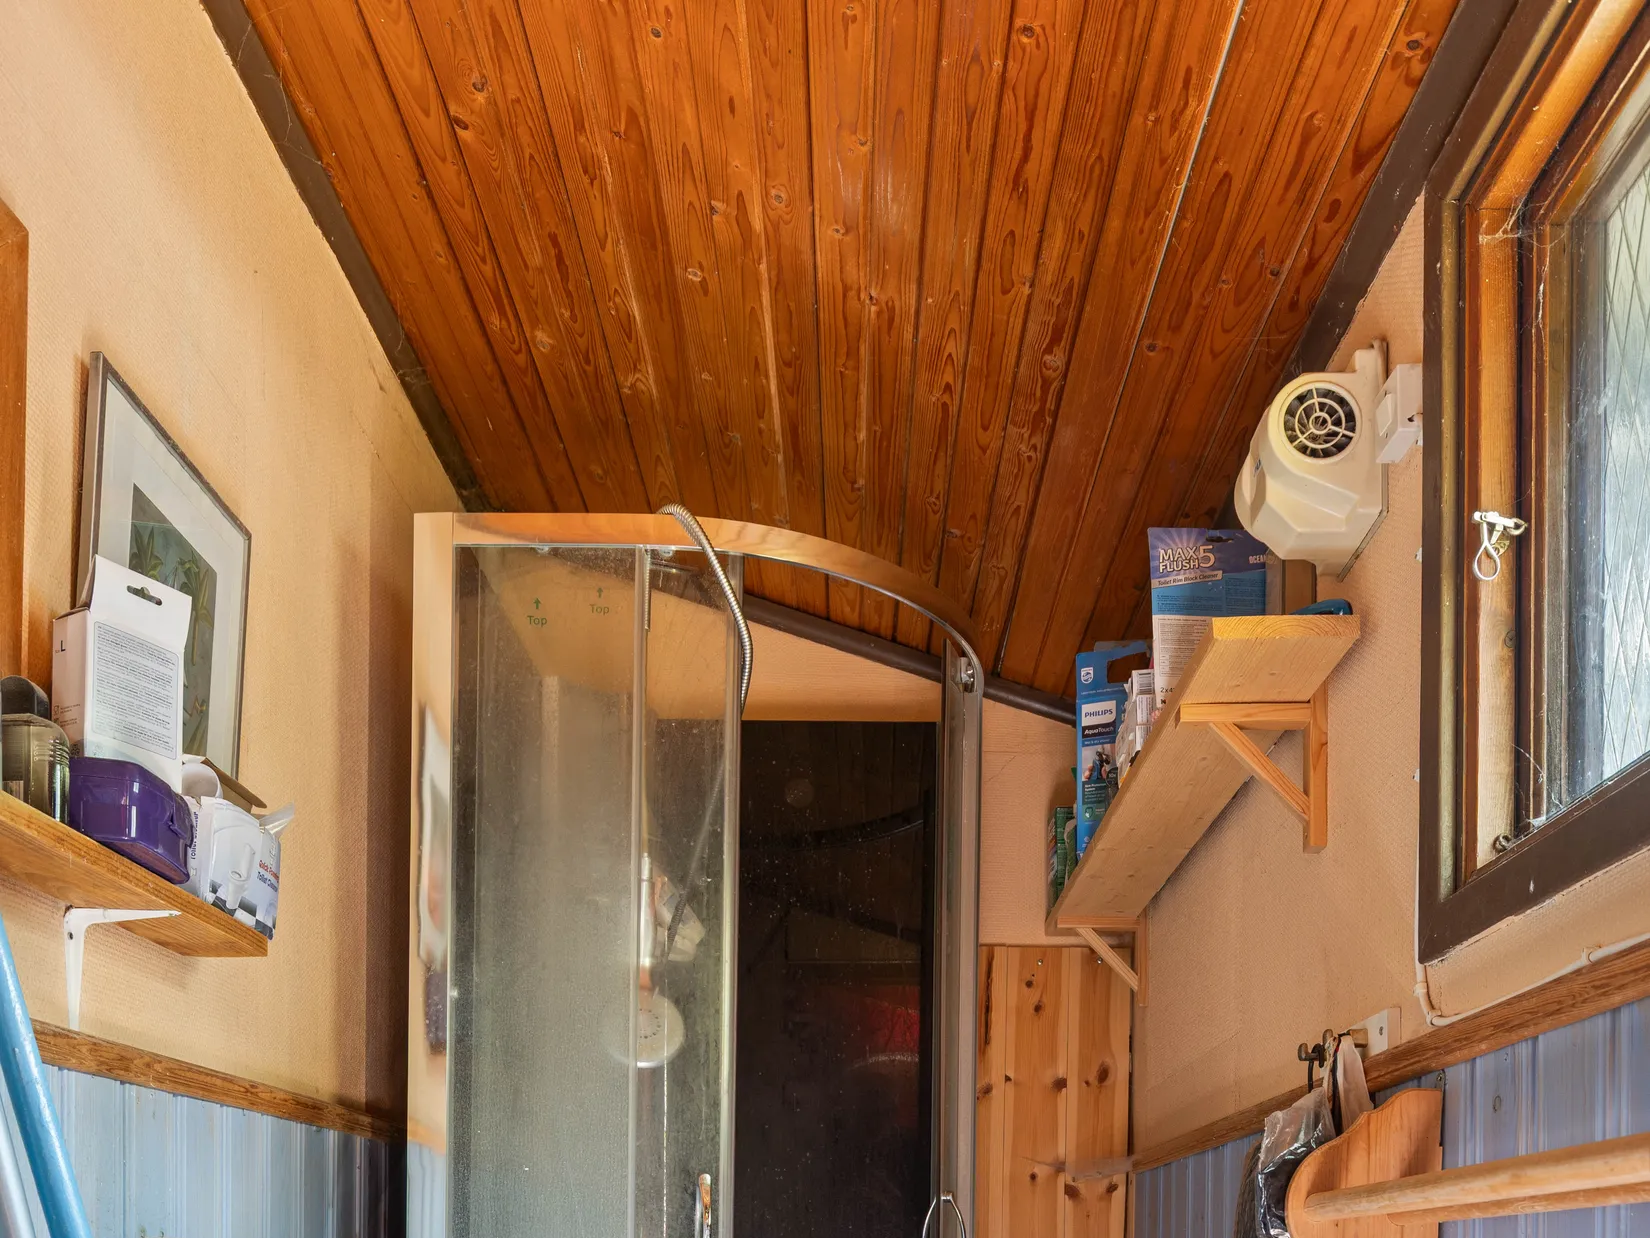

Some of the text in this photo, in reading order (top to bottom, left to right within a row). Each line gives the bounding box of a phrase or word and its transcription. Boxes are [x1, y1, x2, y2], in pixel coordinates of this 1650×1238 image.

[1159, 545, 1216, 568] MAX 5
[1159, 558, 1199, 573] FLUSH
[1184, 574, 1198, 582] Block
[1199, 572, 1219, 580] Cleaner
[590, 604, 610, 615] Top
[527, 615, 548, 627] Top
[60, 640, 66, 652] L
[1084, 708, 1114, 718] PHILIPS
